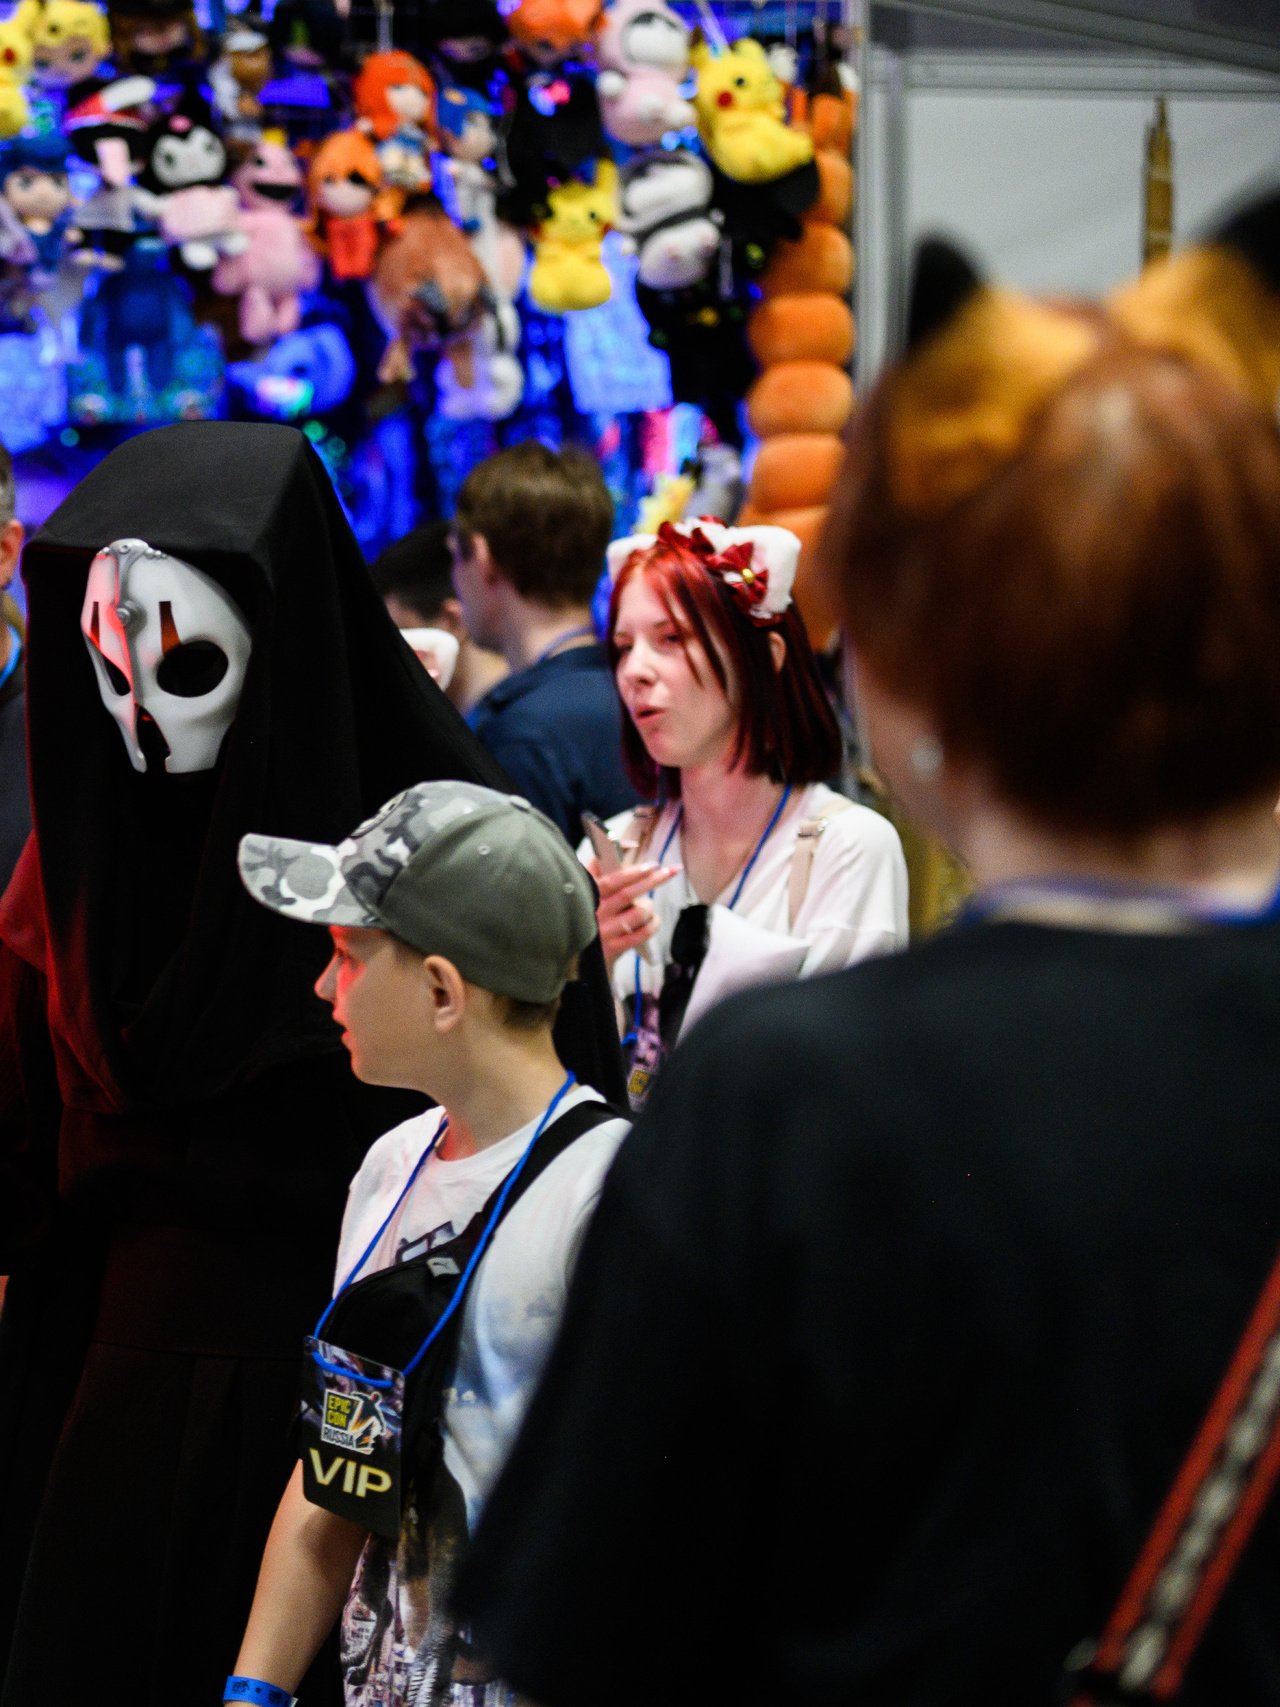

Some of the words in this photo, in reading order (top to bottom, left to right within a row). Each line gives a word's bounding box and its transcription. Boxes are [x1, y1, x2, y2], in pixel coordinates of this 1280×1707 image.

[328, 1394, 351, 1414] EPIC
[326, 1410, 347, 1428] CON
[323, 1427, 354, 1447] RUSSIA
[309, 1447, 392, 1498] VIP
